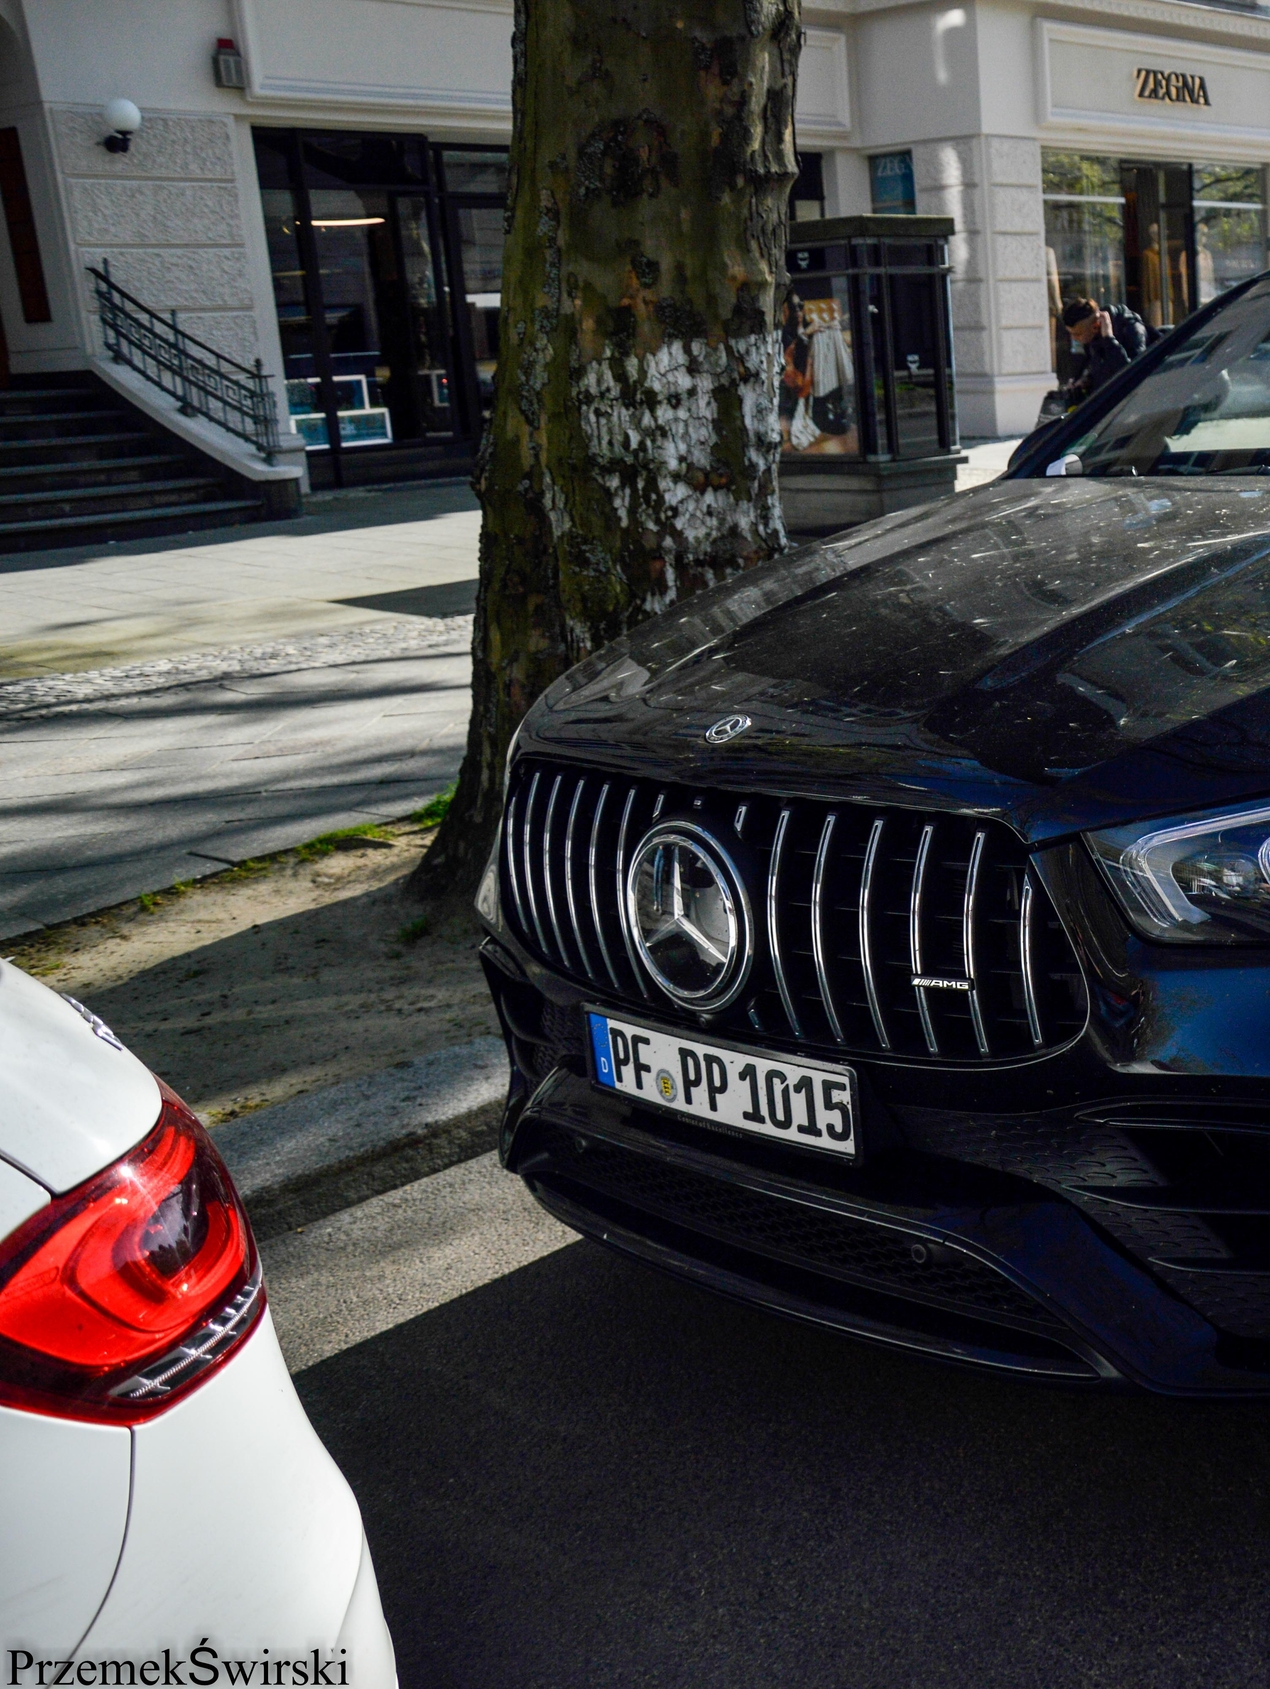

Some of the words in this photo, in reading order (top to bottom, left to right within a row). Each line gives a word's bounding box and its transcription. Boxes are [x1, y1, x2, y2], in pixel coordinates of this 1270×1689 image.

[1136, 67, 1211, 106] ZEGNA
[930, 979, 969, 990] AMG
[600, 1056, 609, 1073] D
[609, 1026, 652, 1091] PF
[677, 1046, 729, 1113] PP
[738, 1062, 852, 1143] 1015
